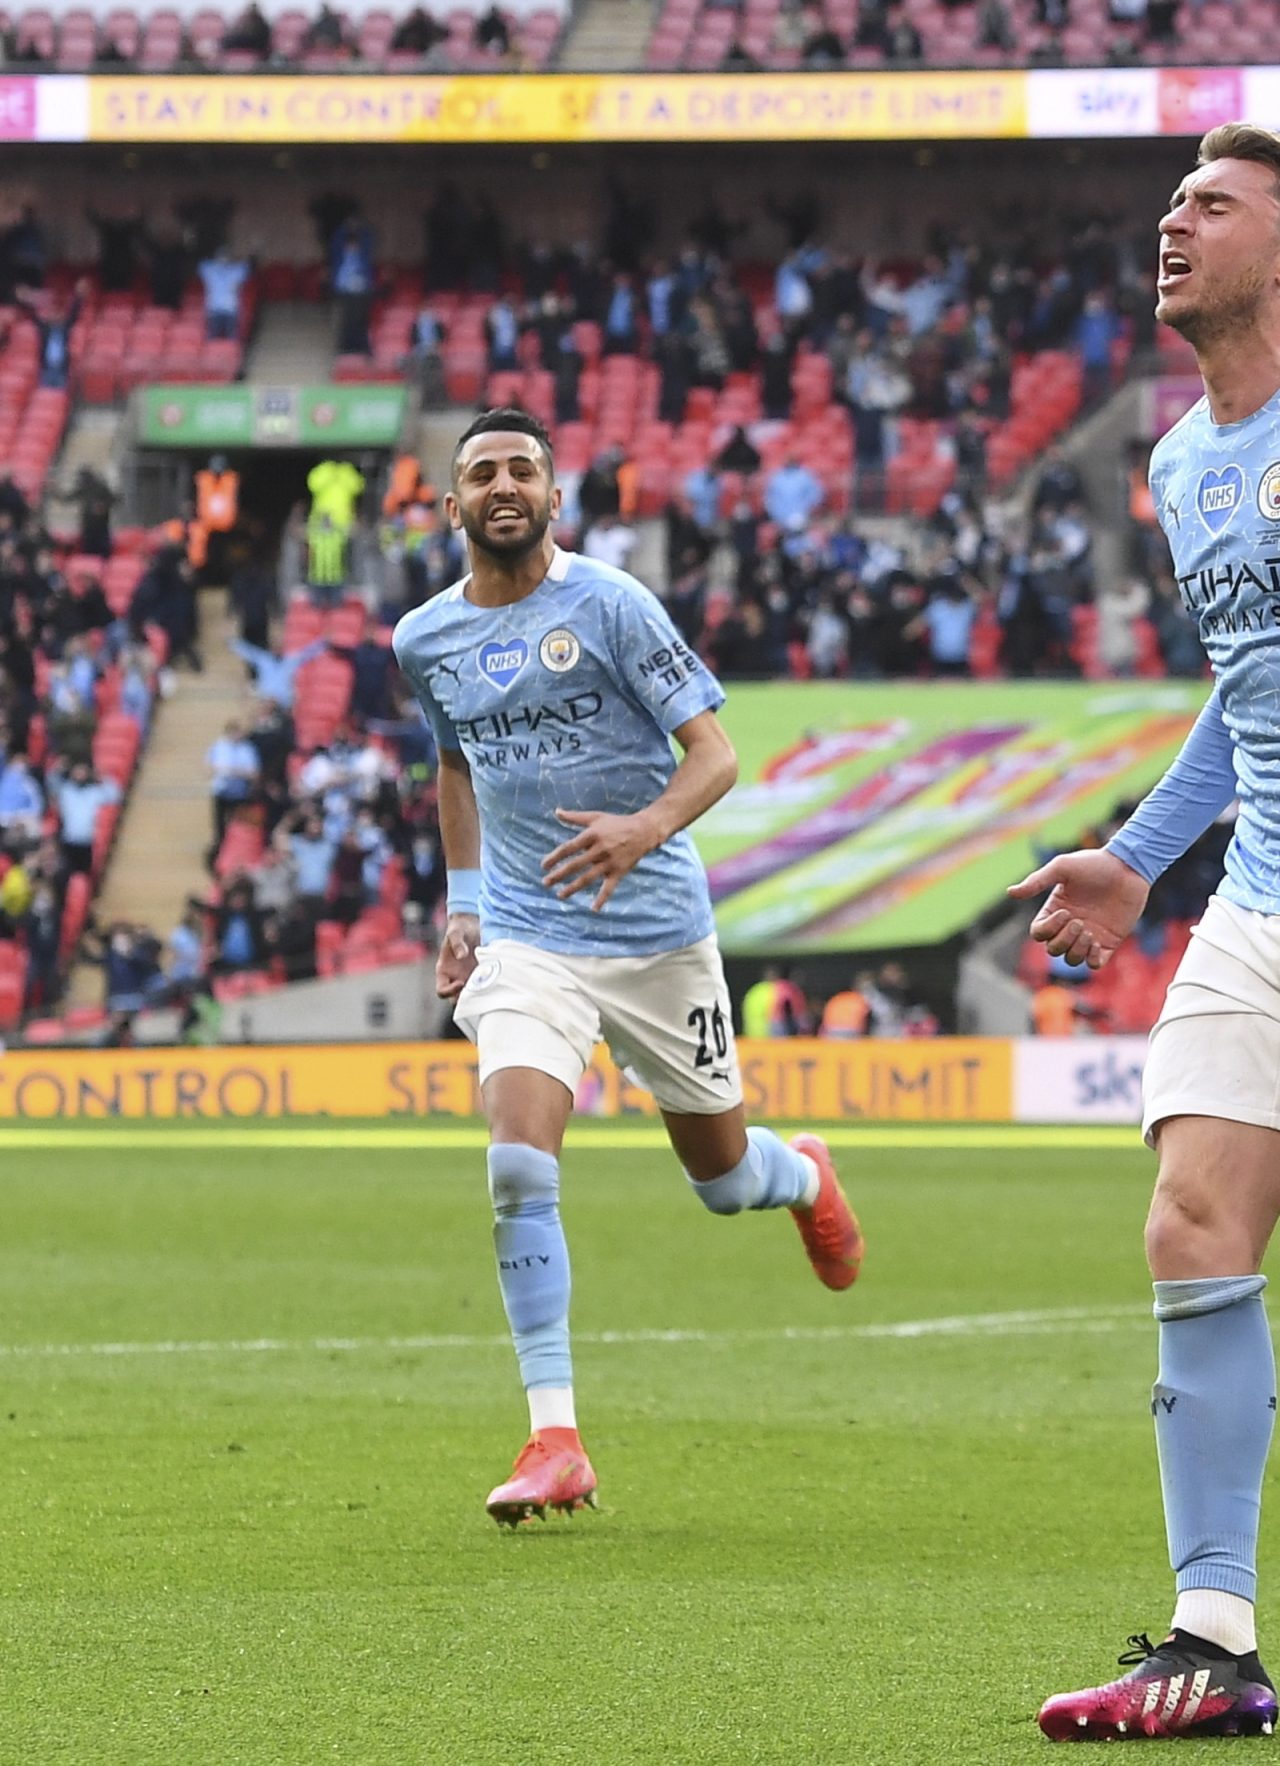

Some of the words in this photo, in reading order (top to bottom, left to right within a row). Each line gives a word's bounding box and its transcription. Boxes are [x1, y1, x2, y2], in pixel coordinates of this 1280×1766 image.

[104, 91, 207, 126] STAY
[222, 92, 272, 125] IN
[1204, 486, 1234, 510] NHS
[488, 653, 520, 670] NHS
[638, 640, 687, 678] NEE
